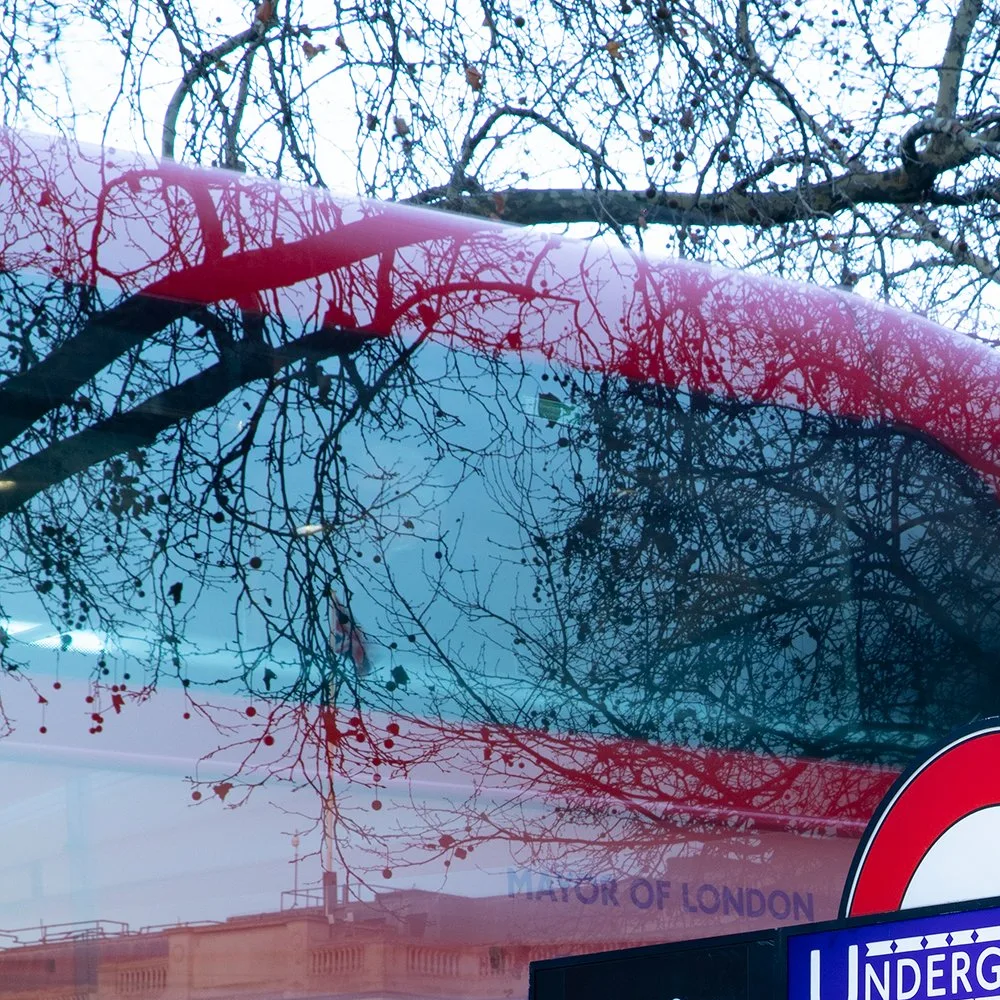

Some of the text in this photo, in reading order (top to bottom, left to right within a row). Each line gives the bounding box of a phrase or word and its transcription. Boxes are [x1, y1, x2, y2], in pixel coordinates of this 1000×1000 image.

[507, 867, 815, 922] MAYOR OF LONDON
